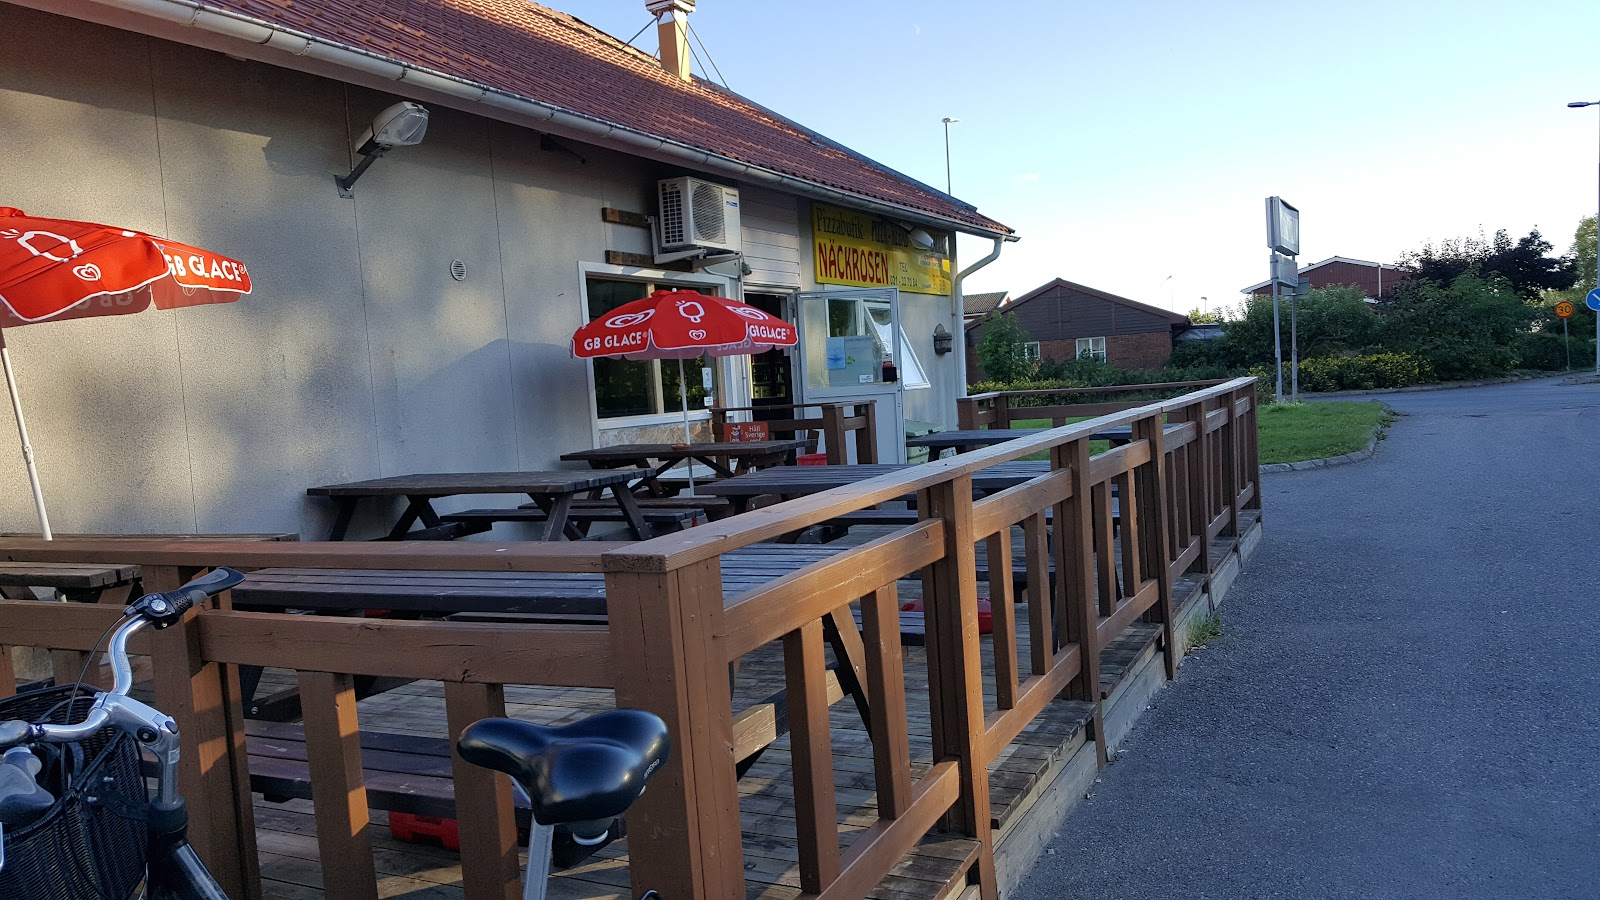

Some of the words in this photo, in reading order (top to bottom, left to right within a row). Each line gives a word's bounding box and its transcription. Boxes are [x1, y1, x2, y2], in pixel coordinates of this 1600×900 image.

[816, 207, 864, 239] Pizzabutik
[164, 254, 187, 277] GB
[818, 239, 889, 284] NÄCKROSEN
[1558, 305, 1571, 314] 30
[584, 337, 601, 351] GB
